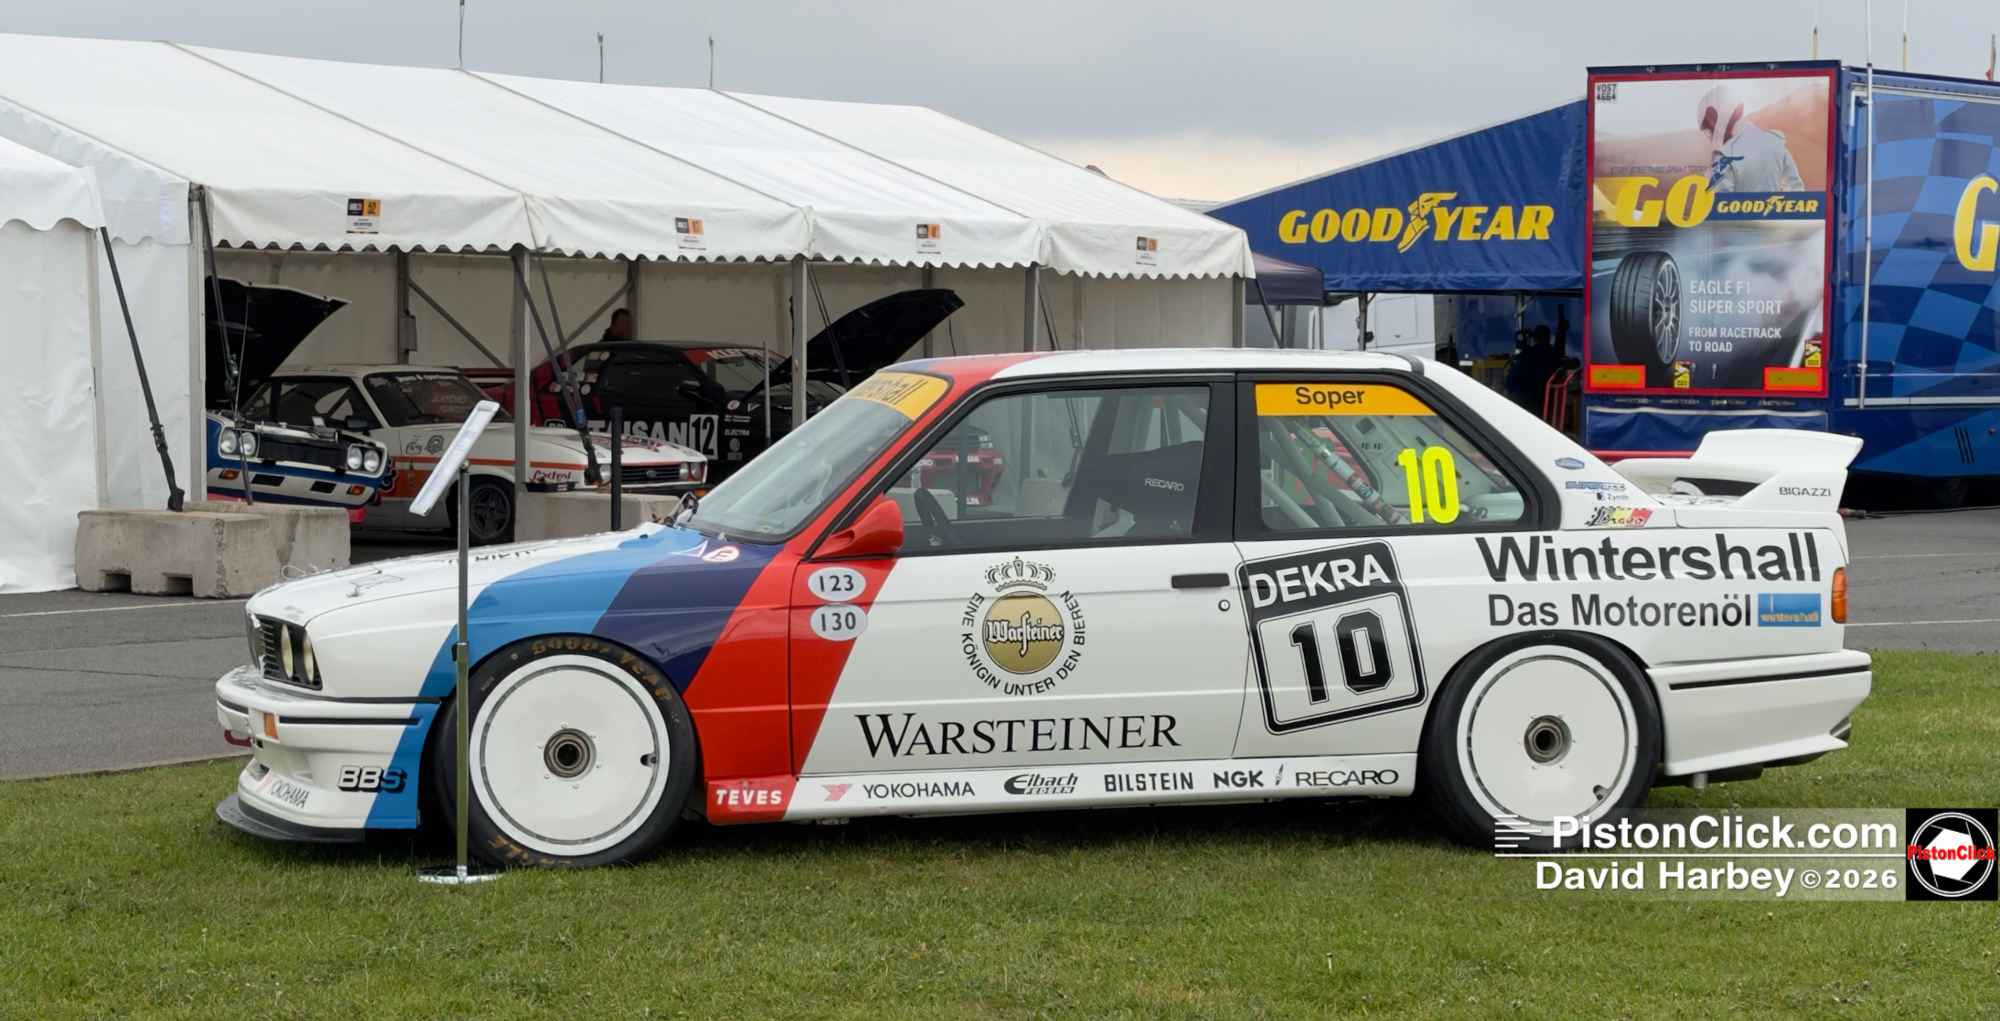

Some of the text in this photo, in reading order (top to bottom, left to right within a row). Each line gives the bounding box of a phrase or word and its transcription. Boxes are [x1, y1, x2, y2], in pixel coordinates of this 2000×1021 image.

[1690, 280, 1751, 295] EAGLE F1
[1690, 300, 1783, 315] SUPER SPORT
[1688, 326, 1782, 339] FROM RACETRACK
[1688, 340, 1733, 353] TO ROAD
[1295, 386, 1365, 410] Soper
[692, 416, 716, 457] 12
[1144, 477, 1185, 492] RECARO
[1397, 445, 1460, 524] 10
[1779, 486, 1832, 497] BIGAZZI
[1475, 532, 1821, 582] Wintershall
[819, 574, 854, 592] 123
[1248, 554, 1391, 608] DEKRA
[1488, 593, 1751, 627] Das Motorenöl
[821, 611, 856, 632] 130
[962, 590, 1085, 696] EINE KÖNIGIN UNTER DEN BIEREN
[1288, 608, 1394, 705] 10
[337, 765, 407, 793] BBS
[1003, 773, 1079, 795] Eibach
[1104, 771, 1194, 792] BILSTEIN
[1213, 769, 1264, 788] NGK
[1295, 769, 1399, 787] RECARO
[715, 788, 783, 806] TEVES
[862, 782, 976, 799] YOKOHAMA
